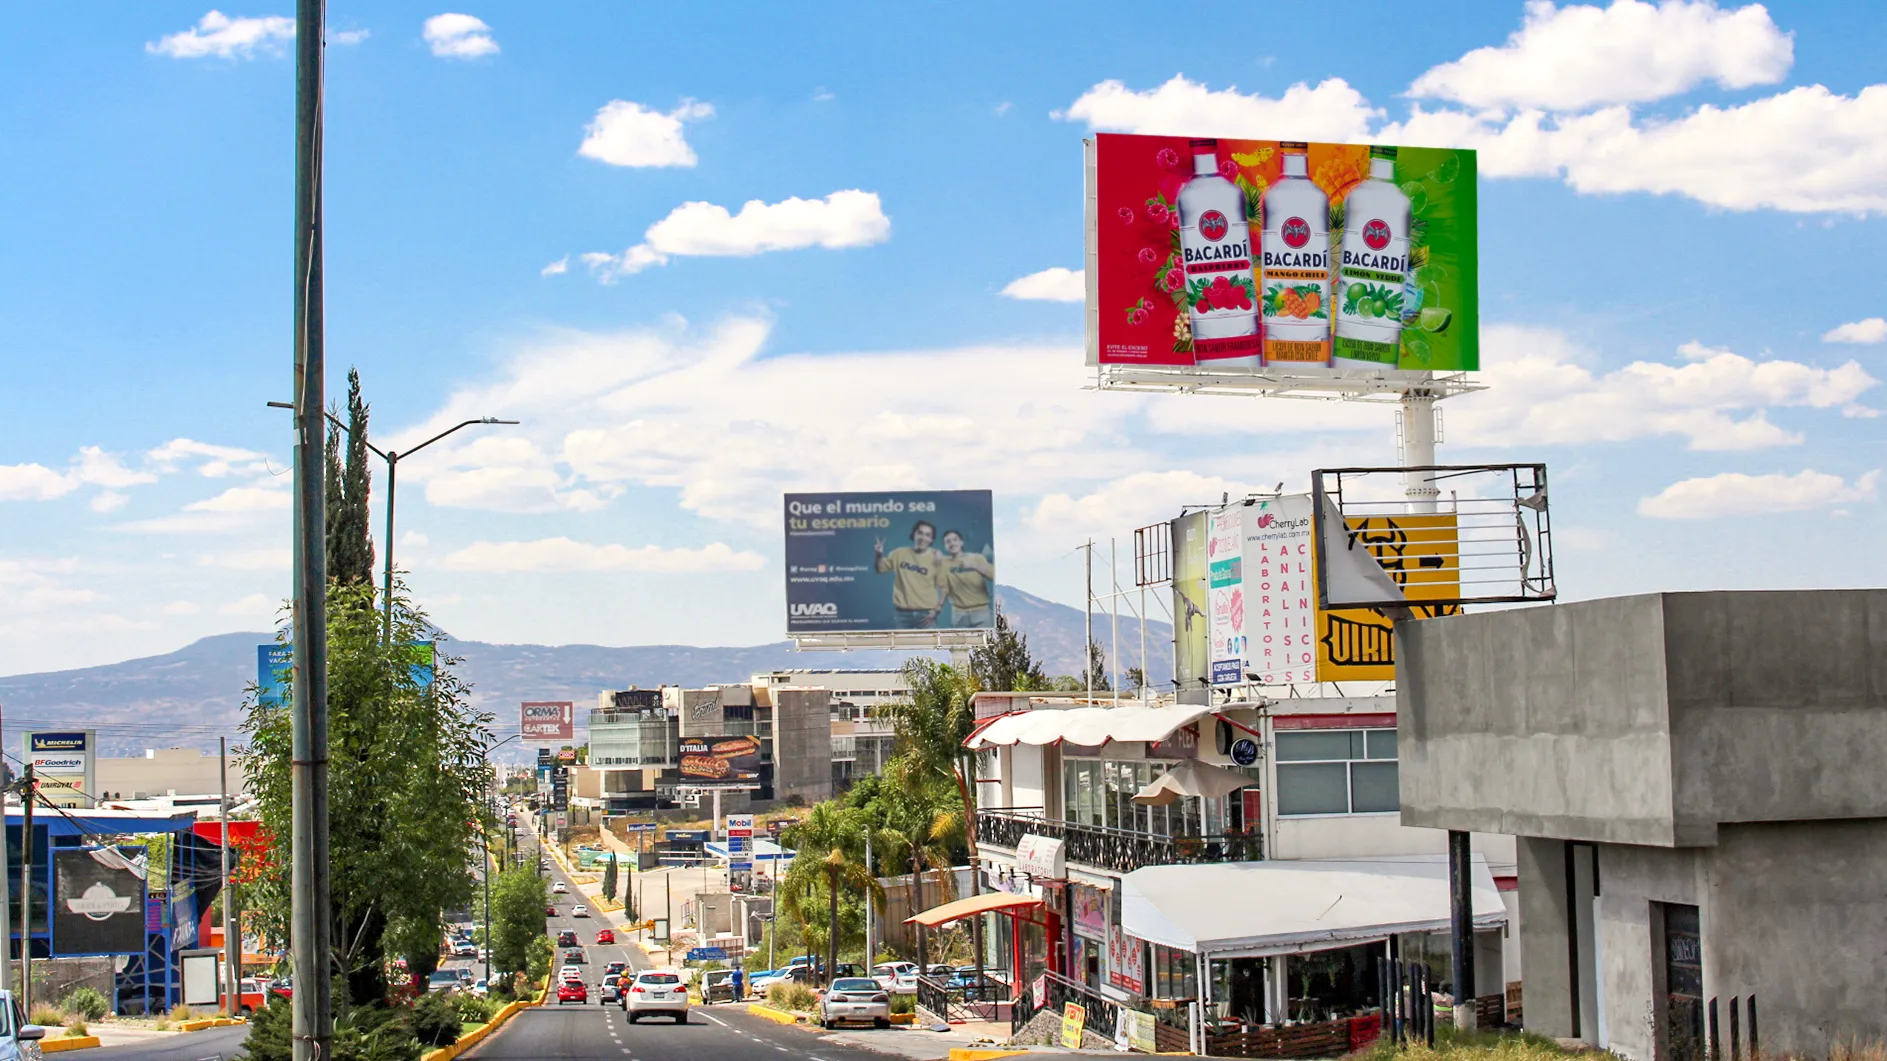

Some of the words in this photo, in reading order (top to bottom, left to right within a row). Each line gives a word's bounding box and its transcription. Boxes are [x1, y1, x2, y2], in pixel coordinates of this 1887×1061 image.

[1184, 239, 1248, 262] BACARDÍ
[1264, 250, 1328, 268] BACARDÍ
[1343, 250, 1406, 273] BACARDÍ
[789, 501, 822, 516] Que
[826, 500, 841, 514] el
[846, 500, 904, 513] mundo
[908, 501, 936, 512] sea
[789, 517, 807, 529] tu
[812, 515, 890, 529] escenario
[1270, 517, 1309, 530] CherryLab
[790, 603, 838, 615] UVAQ
[1260, 542, 1274, 683] LABORATORIO
[1279, 545, 1293, 682] ANALISIS
[1297, 543, 1312, 681] CLINICOS
[525, 706, 560, 717] ORMA
[729, 819, 752, 827] Mobil
